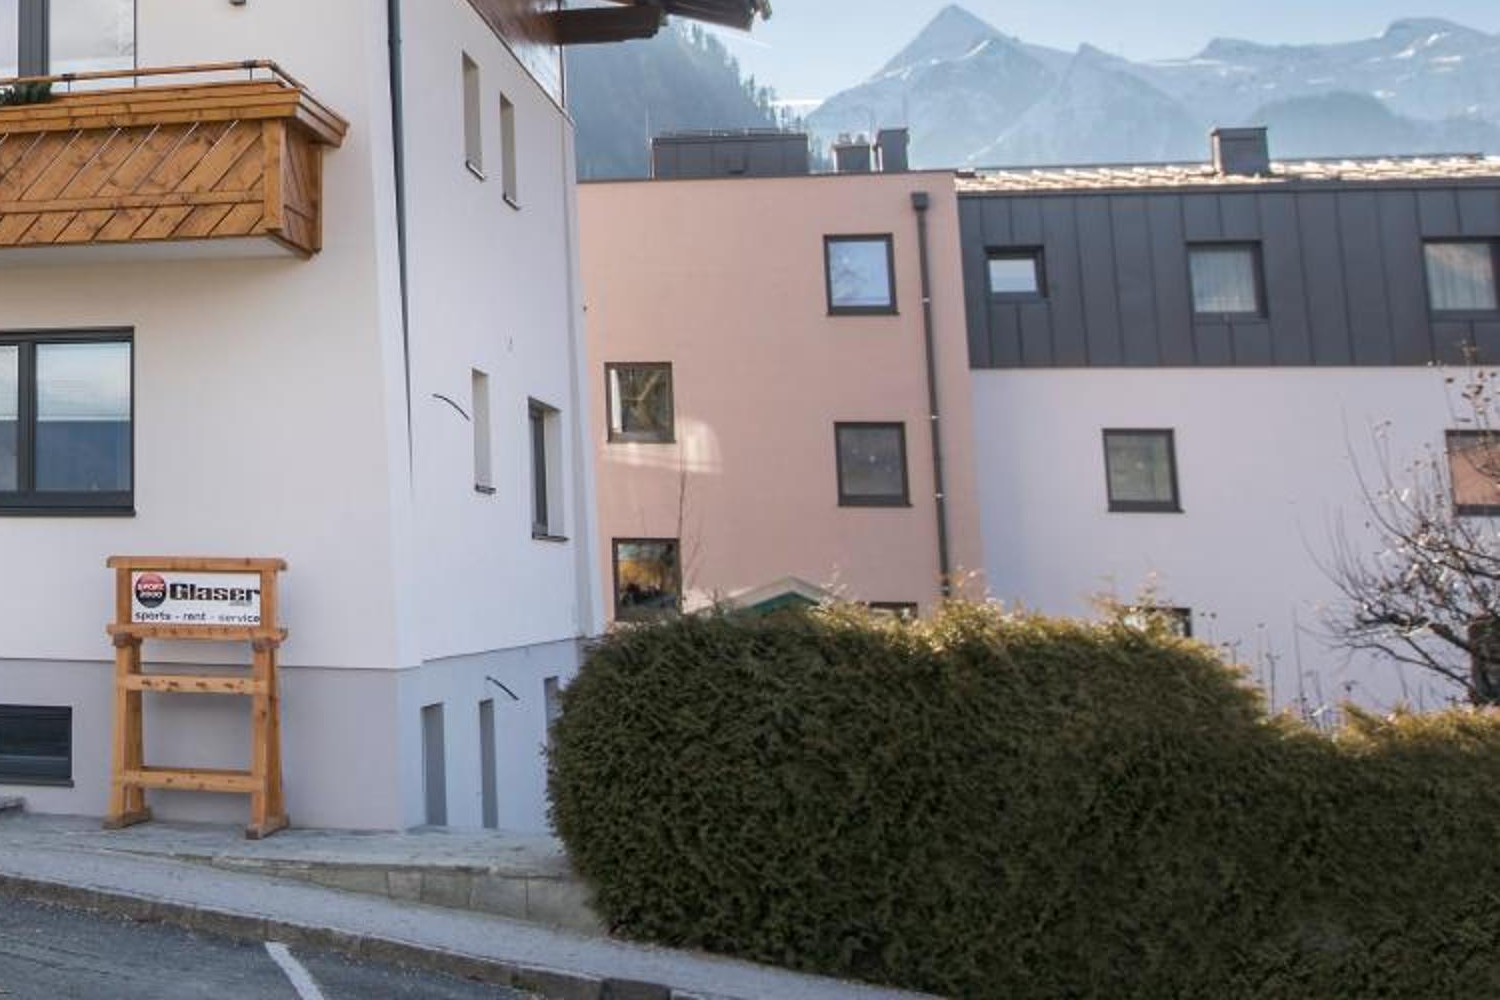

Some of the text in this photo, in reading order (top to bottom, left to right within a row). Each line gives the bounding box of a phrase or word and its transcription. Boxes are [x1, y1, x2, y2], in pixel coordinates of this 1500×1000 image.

[169, 583, 260, 601] Glaser
[135, 611, 171, 622] sports
[183, 612, 206, 621] rent
